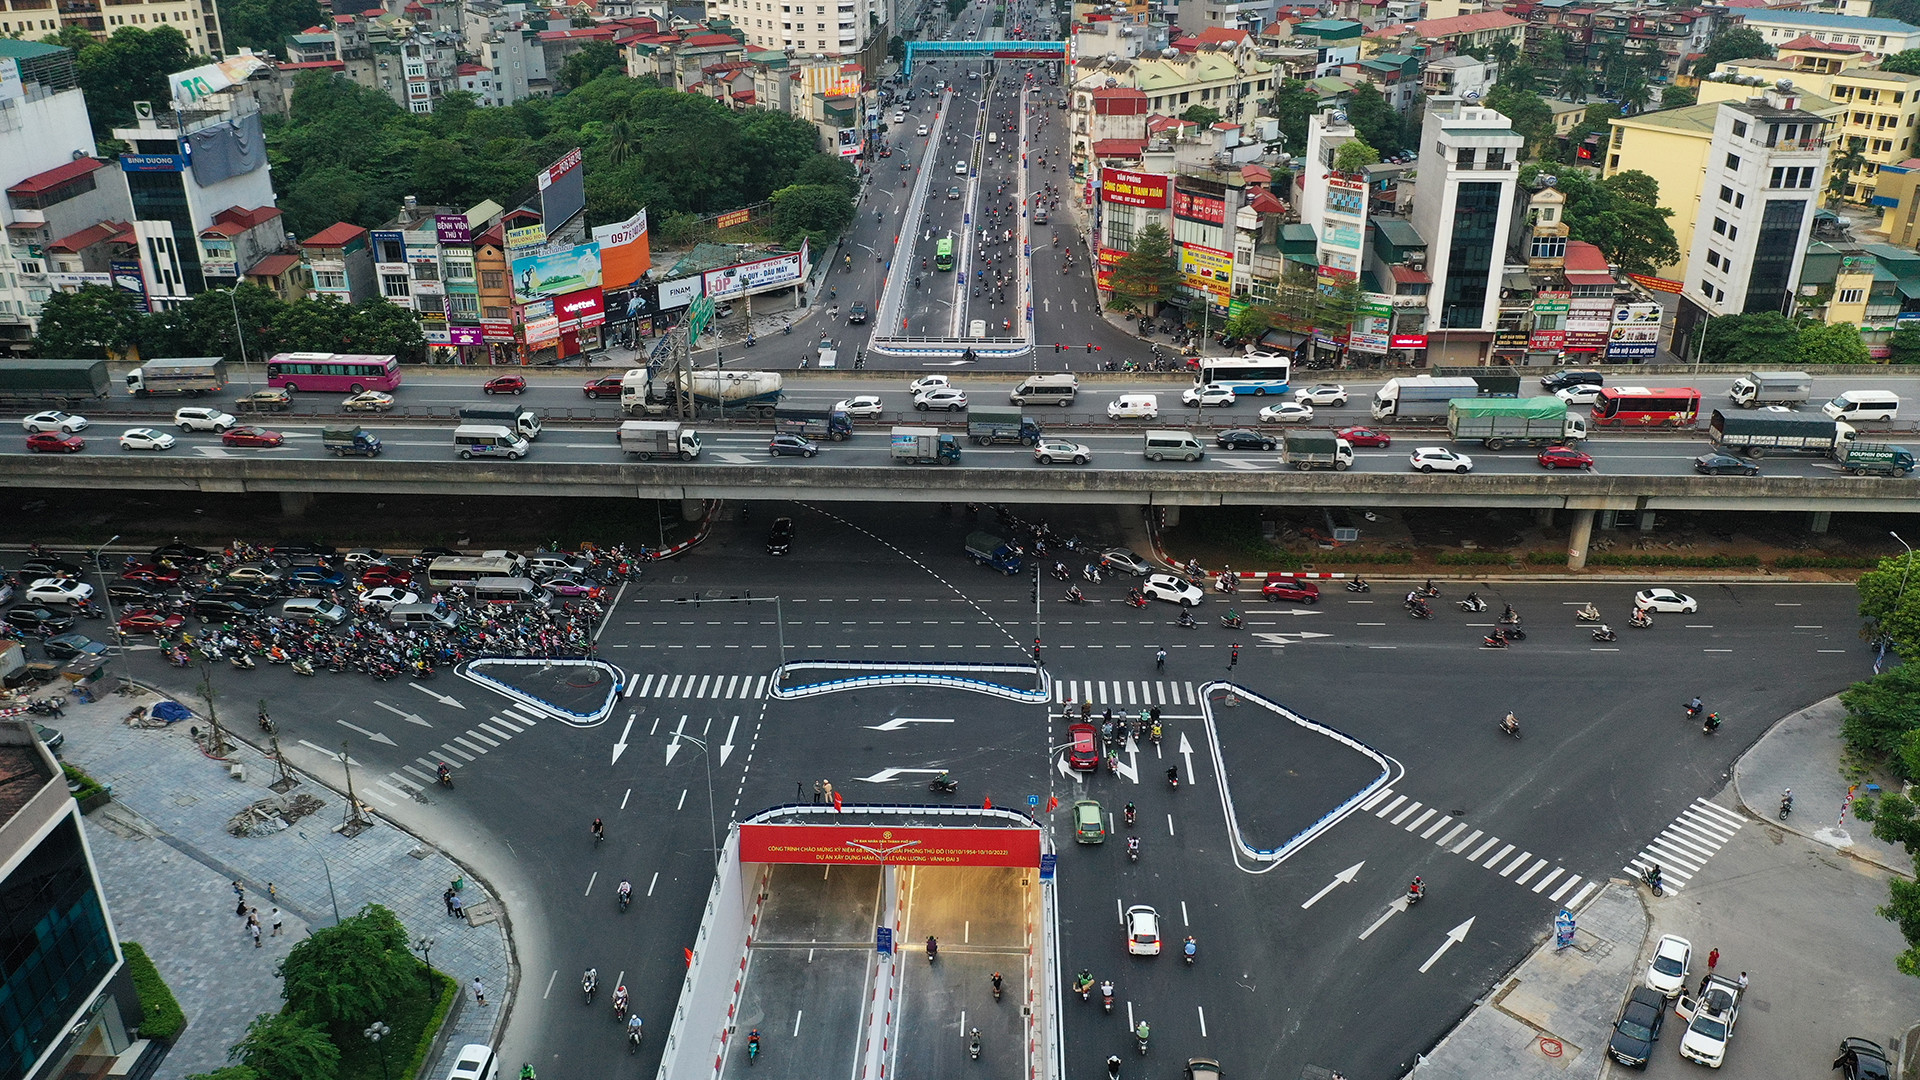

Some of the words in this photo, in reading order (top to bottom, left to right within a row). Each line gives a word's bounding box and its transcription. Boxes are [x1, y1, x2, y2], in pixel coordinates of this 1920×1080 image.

[1103, 181, 1116, 192] CÔNG
[1132, 186, 1149, 197] THANH
[1149, 187, 1163, 198] XUÂN
[437, 221, 453, 230] BỆNH
[453, 221, 468, 230] VIỆN
[458, 231, 463, 239] Y
[669, 286, 691, 296] FINAM
[563, 298, 597, 313] viettel
[1620, 347, 1629, 355] HỘ
[1639, 347, 1655, 355] ĐỘNG
[907, 854, 927, 862] LƯƠNG
[930, 854, 945, 862] VÀNH
